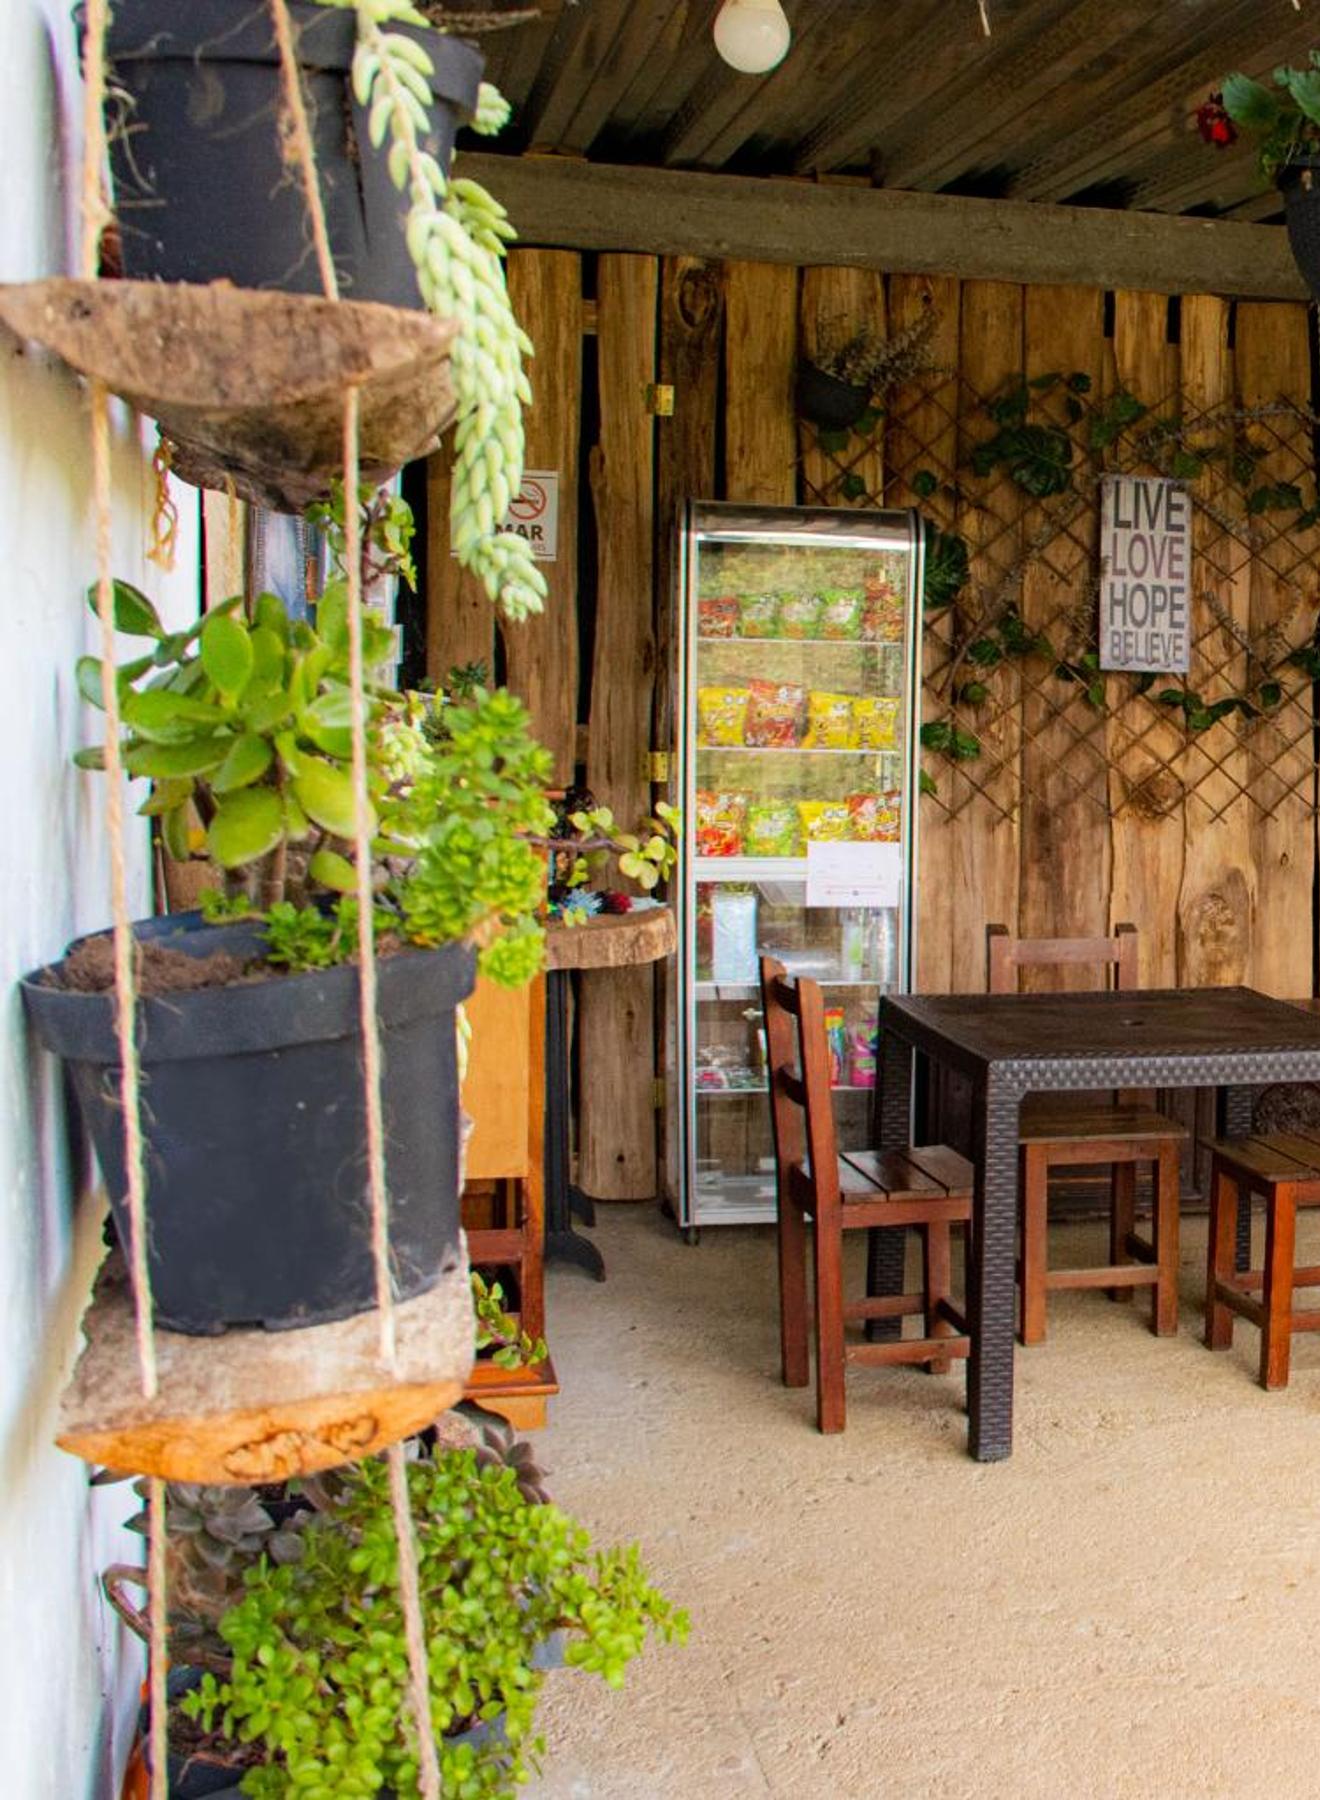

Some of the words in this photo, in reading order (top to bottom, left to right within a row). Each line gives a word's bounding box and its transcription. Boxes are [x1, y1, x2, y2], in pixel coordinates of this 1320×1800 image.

[1113, 480, 1185, 532] LIVE
[495, 523, 545, 541] MAR
[1111, 532, 1184, 579] LOVE
[1109, 582, 1185, 629] HOPE
[1110, 630, 1184, 665] BELIEVE
